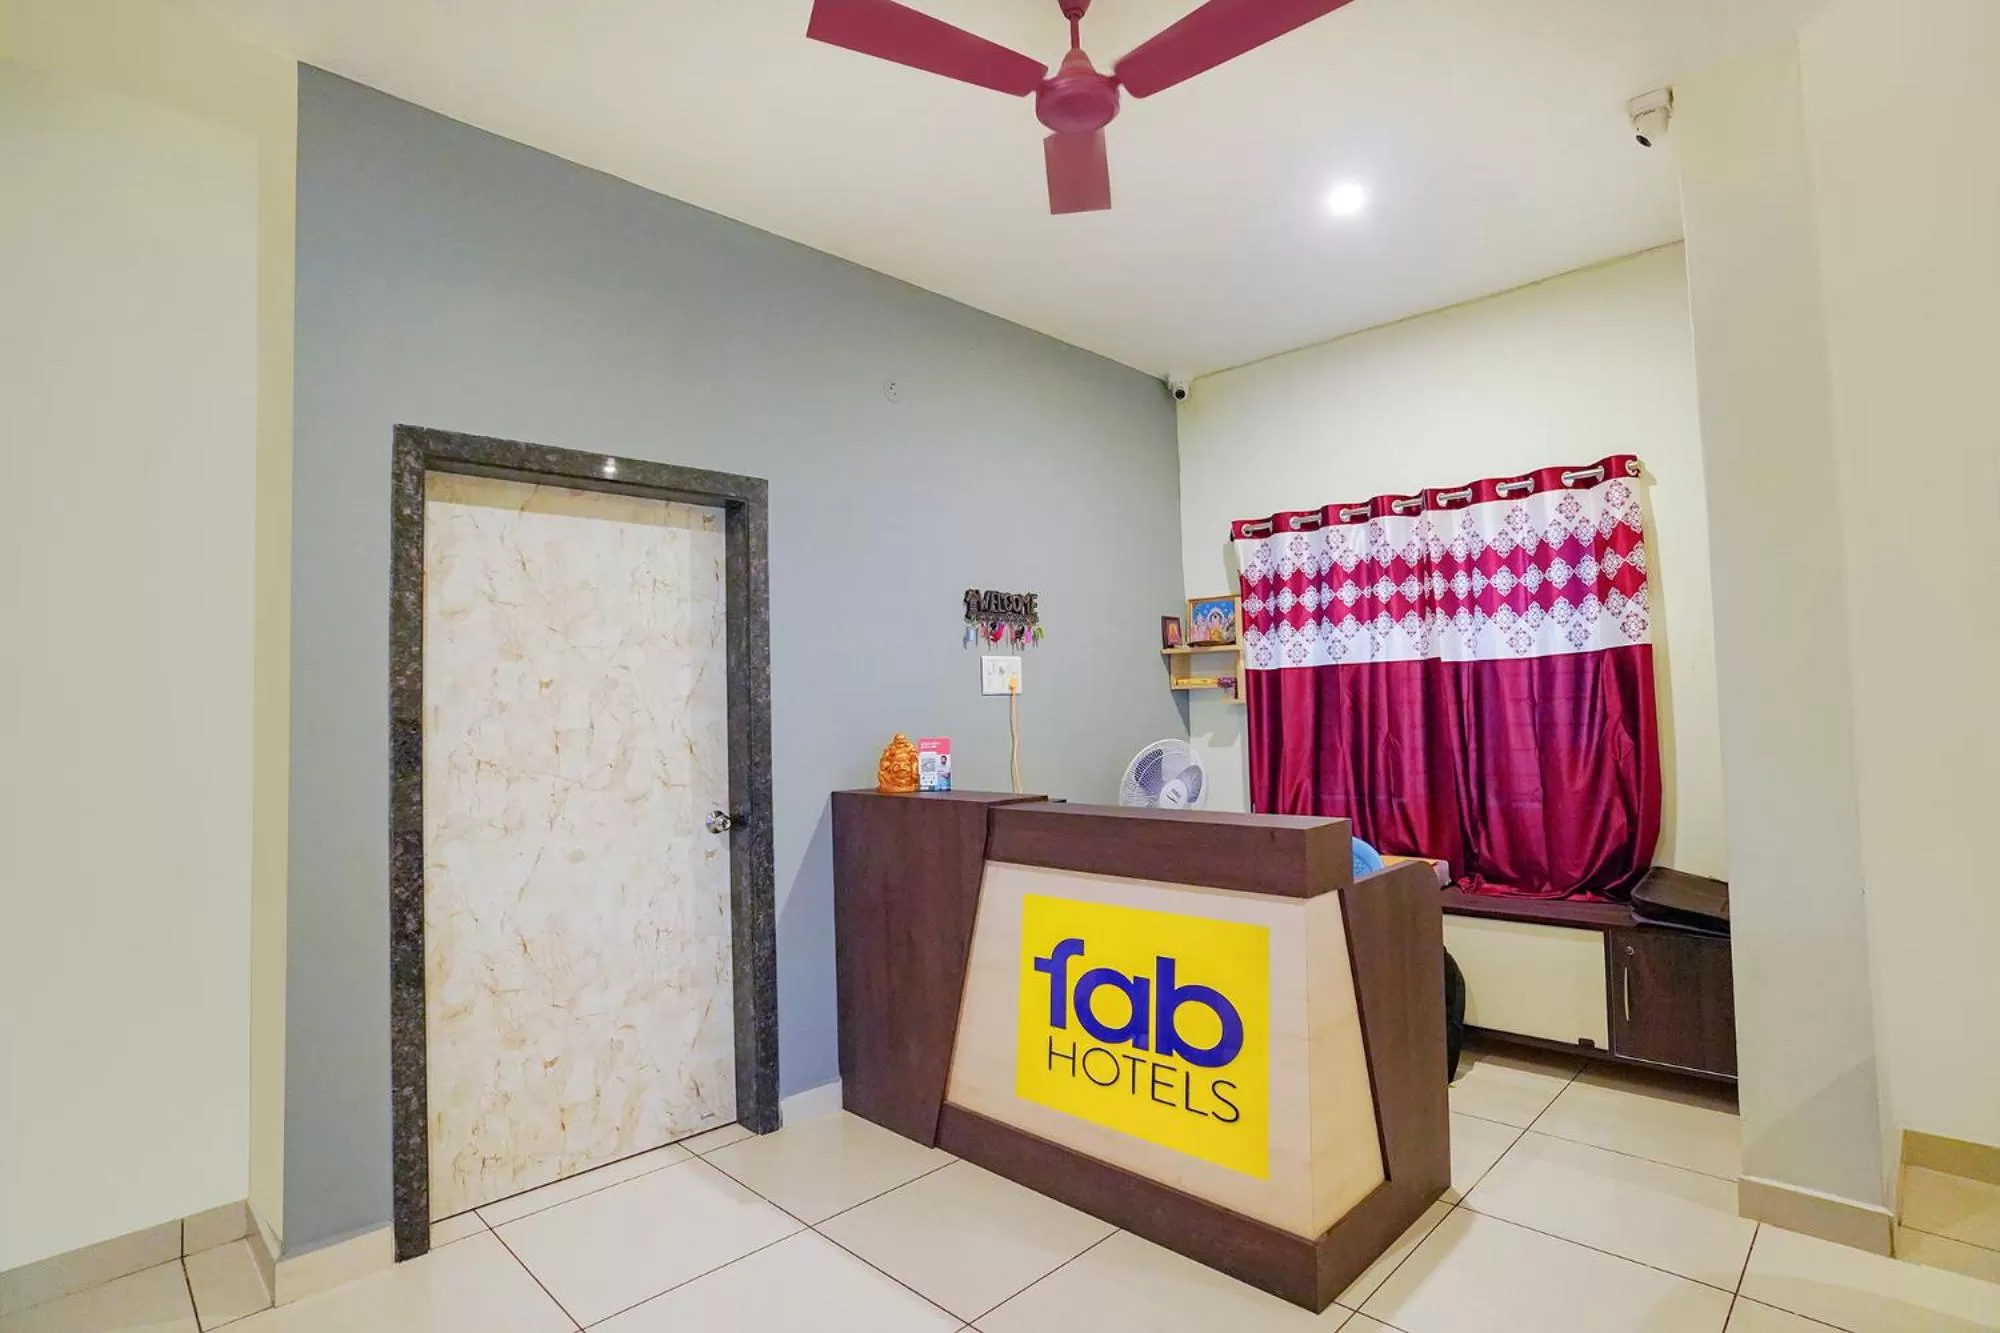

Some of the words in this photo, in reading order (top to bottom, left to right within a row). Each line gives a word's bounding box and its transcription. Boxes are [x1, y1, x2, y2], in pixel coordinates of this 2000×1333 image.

[981, 591, 1038, 615] WELCOME
[1034, 938, 1244, 1068] fab
[1048, 1036, 1240, 1123] HOTELS
